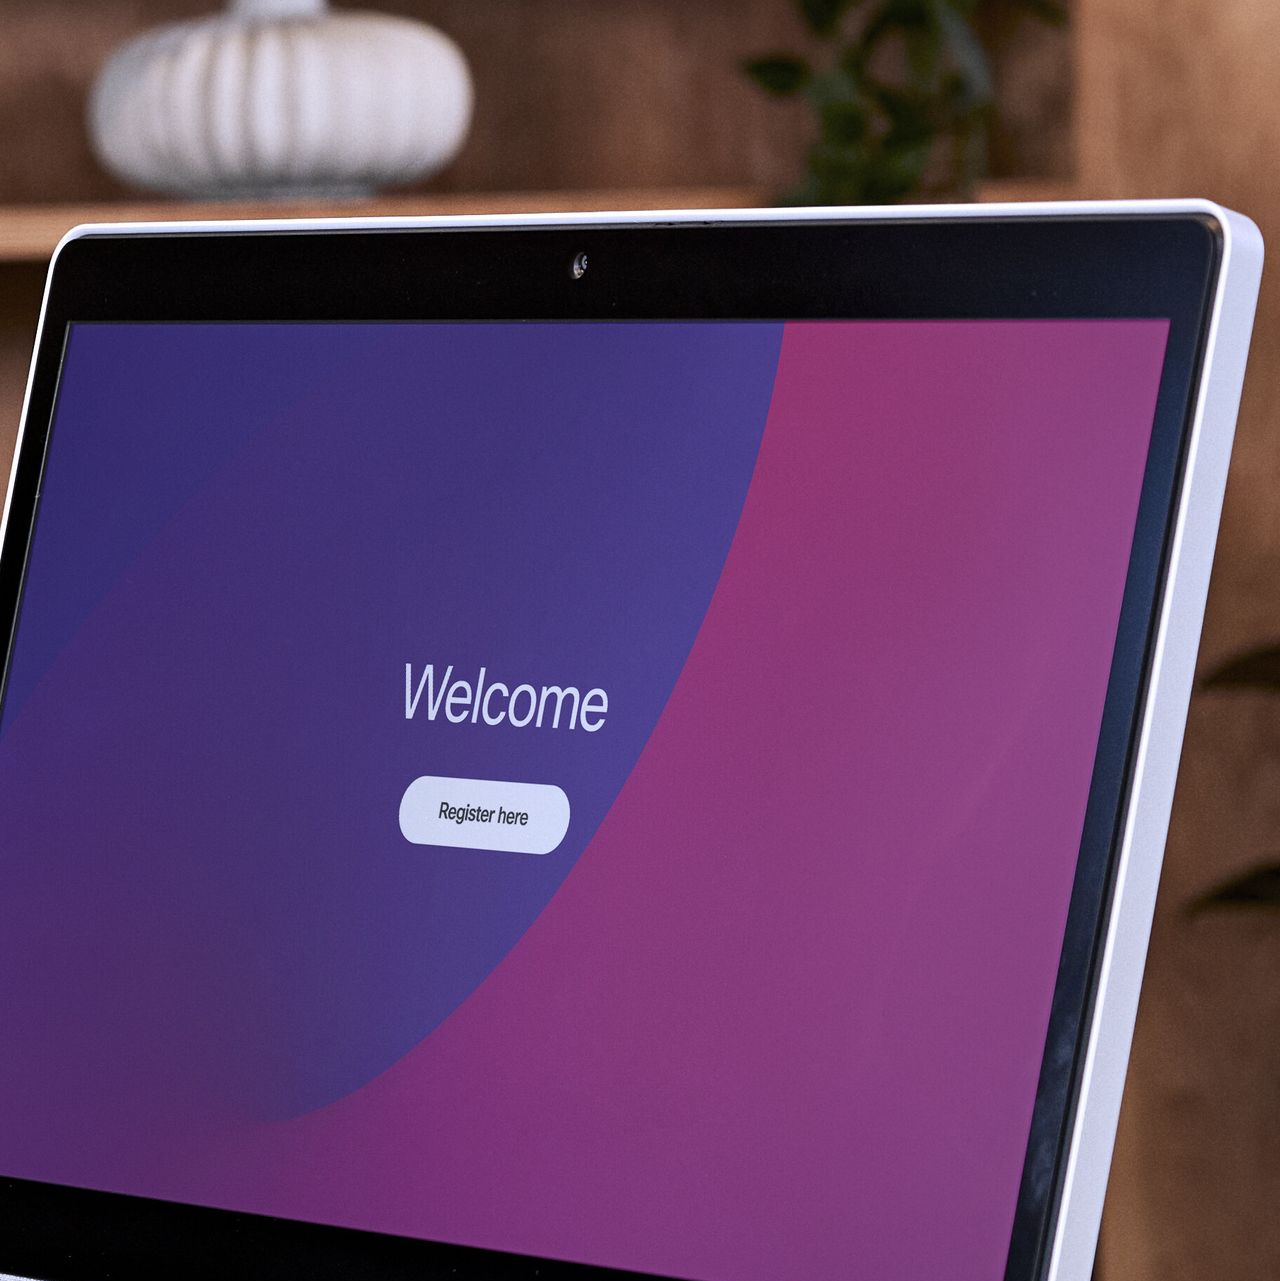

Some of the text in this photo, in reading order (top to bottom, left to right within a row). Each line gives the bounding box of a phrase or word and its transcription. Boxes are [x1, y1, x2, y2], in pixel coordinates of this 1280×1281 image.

[405, 663, 608, 732] Welcome
[438, 801, 529, 826] Register here
